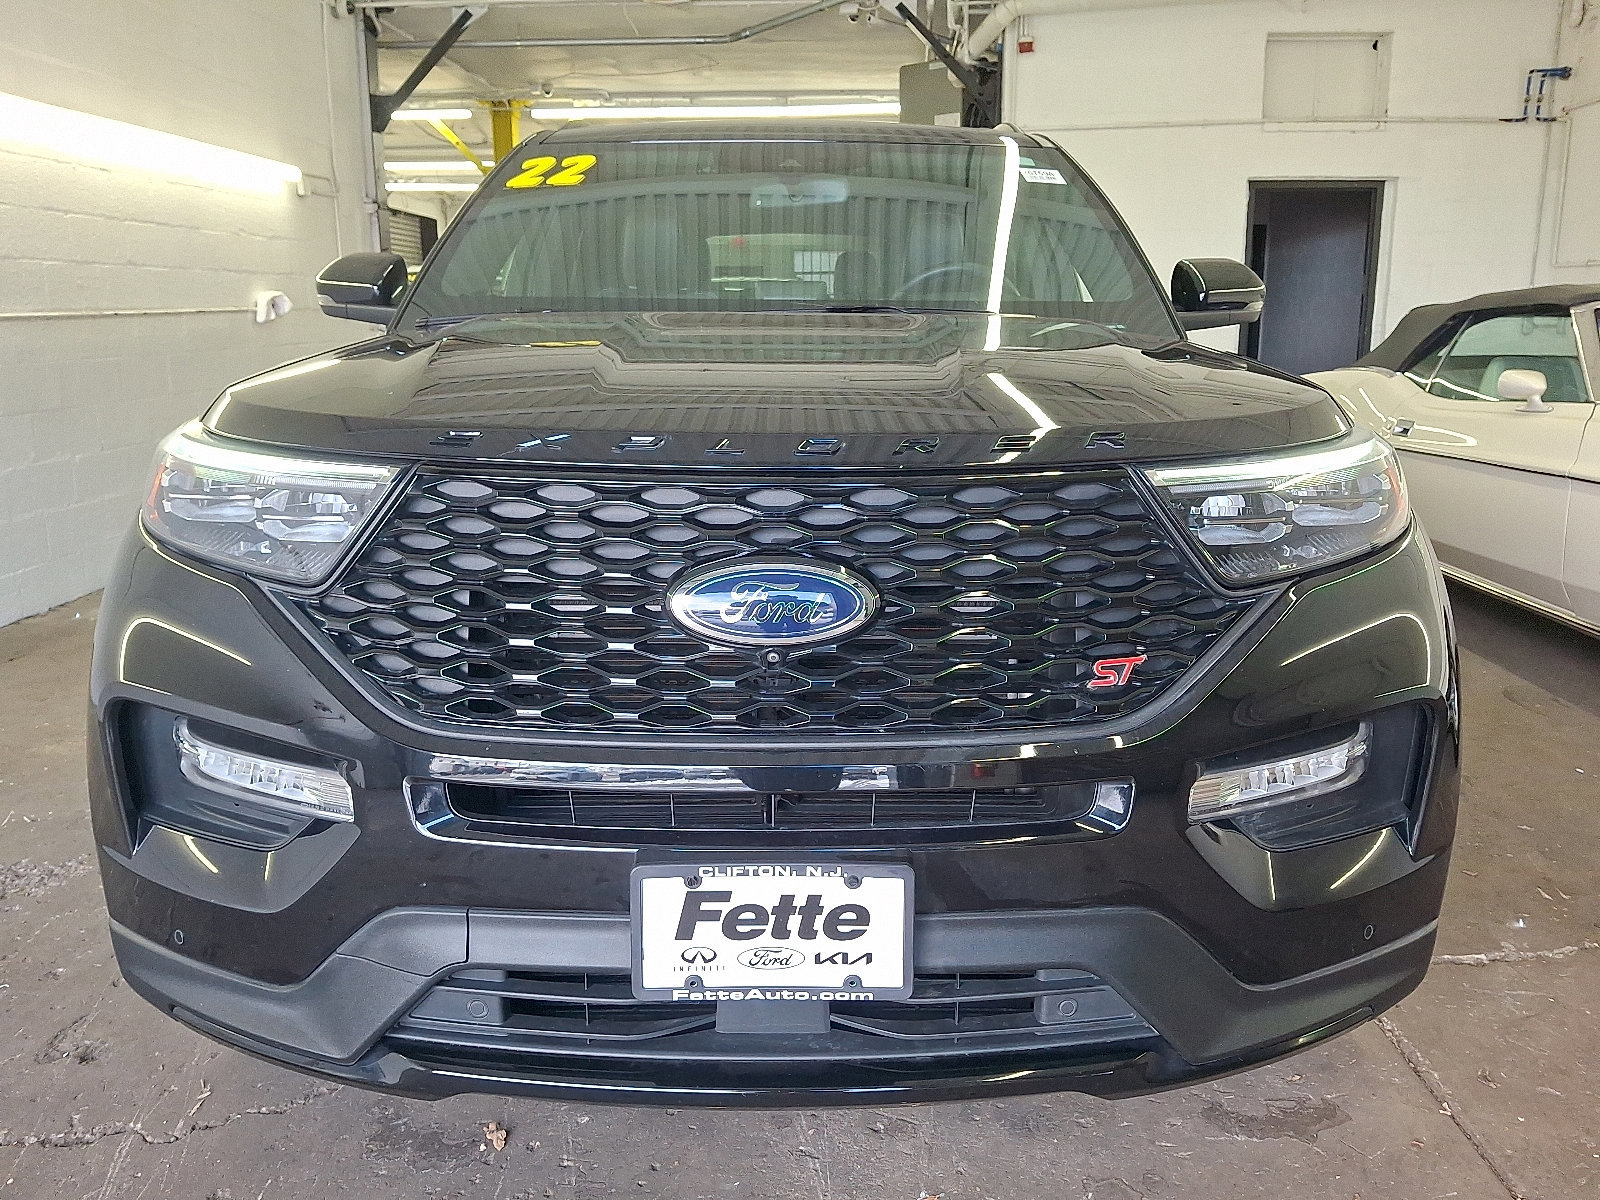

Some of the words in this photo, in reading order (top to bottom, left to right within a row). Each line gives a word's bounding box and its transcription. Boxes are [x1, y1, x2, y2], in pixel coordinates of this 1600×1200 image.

[505, 154, 597, 189] 22
[429, 430, 1126, 456] EXPLORER
[719, 580, 826, 625] Ford
[1086, 654, 1147, 689] ST
[698, 865, 797, 878] CLIFTON,
[806, 865, 849, 878] N.J.
[674, 890, 871, 941] Fette
[748, 949, 793, 967] Ford
[814, 951, 873, 965] KIA
[672, 988, 874, 1001] FetteAuto.com
